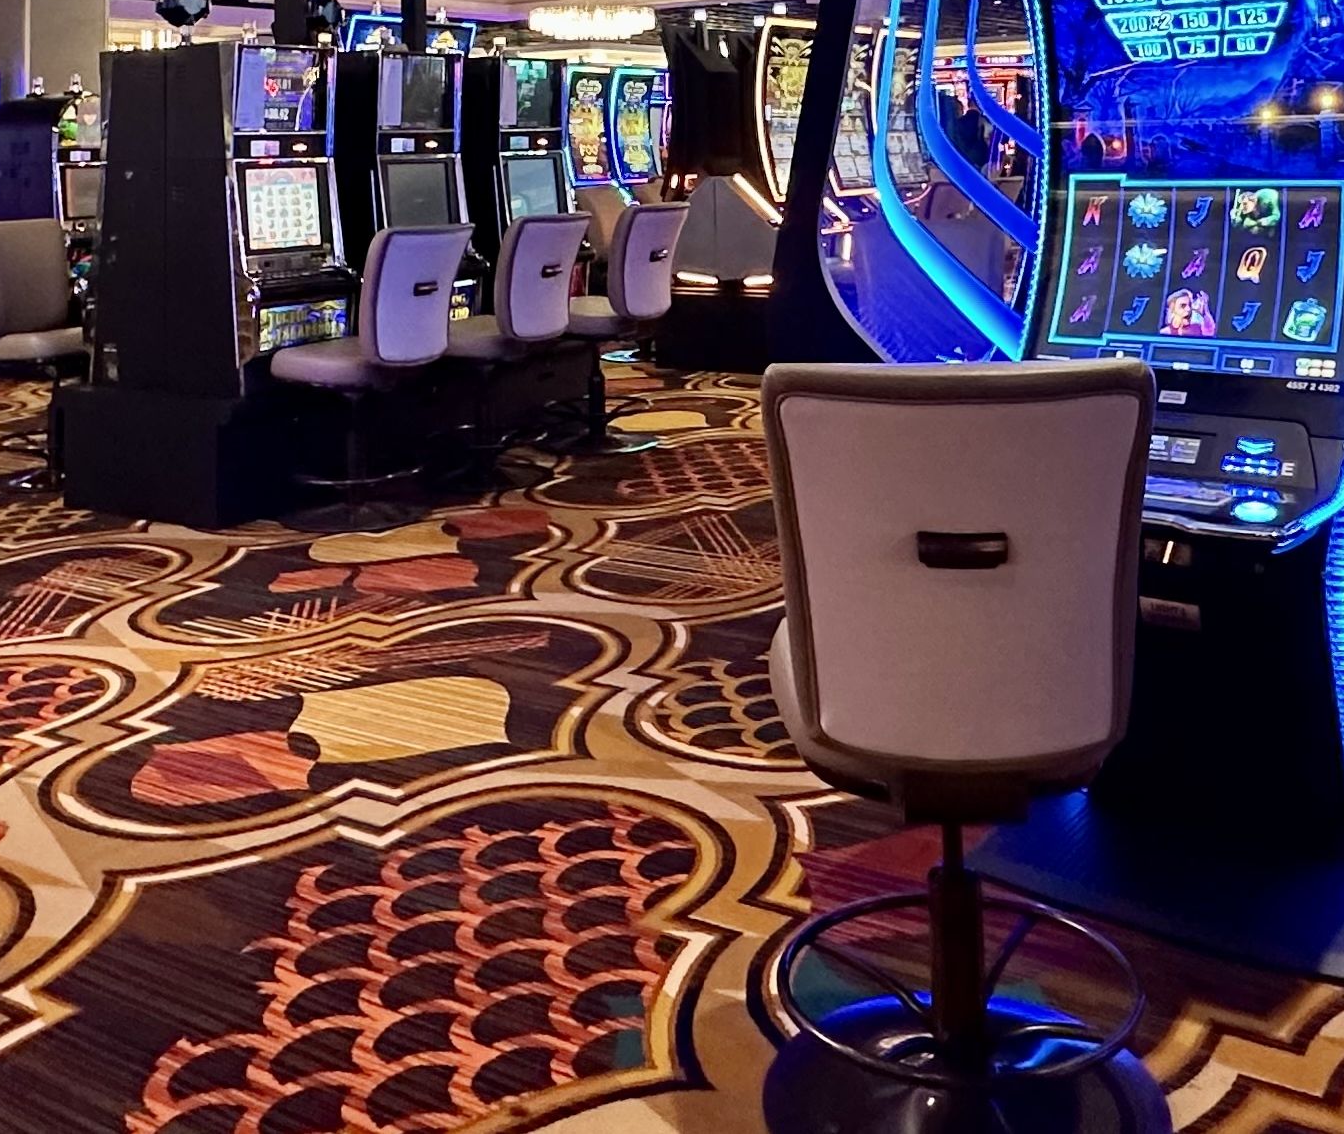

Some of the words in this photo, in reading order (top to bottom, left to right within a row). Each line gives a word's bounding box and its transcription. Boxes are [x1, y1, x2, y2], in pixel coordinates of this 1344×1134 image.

[1117, 14, 1148, 33] 200
[1179, 11, 1210, 29] 150
[1236, 6, 1269, 24] 125
[1134, 41, 1163, 58] 100
[1187, 39, 1207, 55] 75
[1235, 36, 1257, 52] 60
